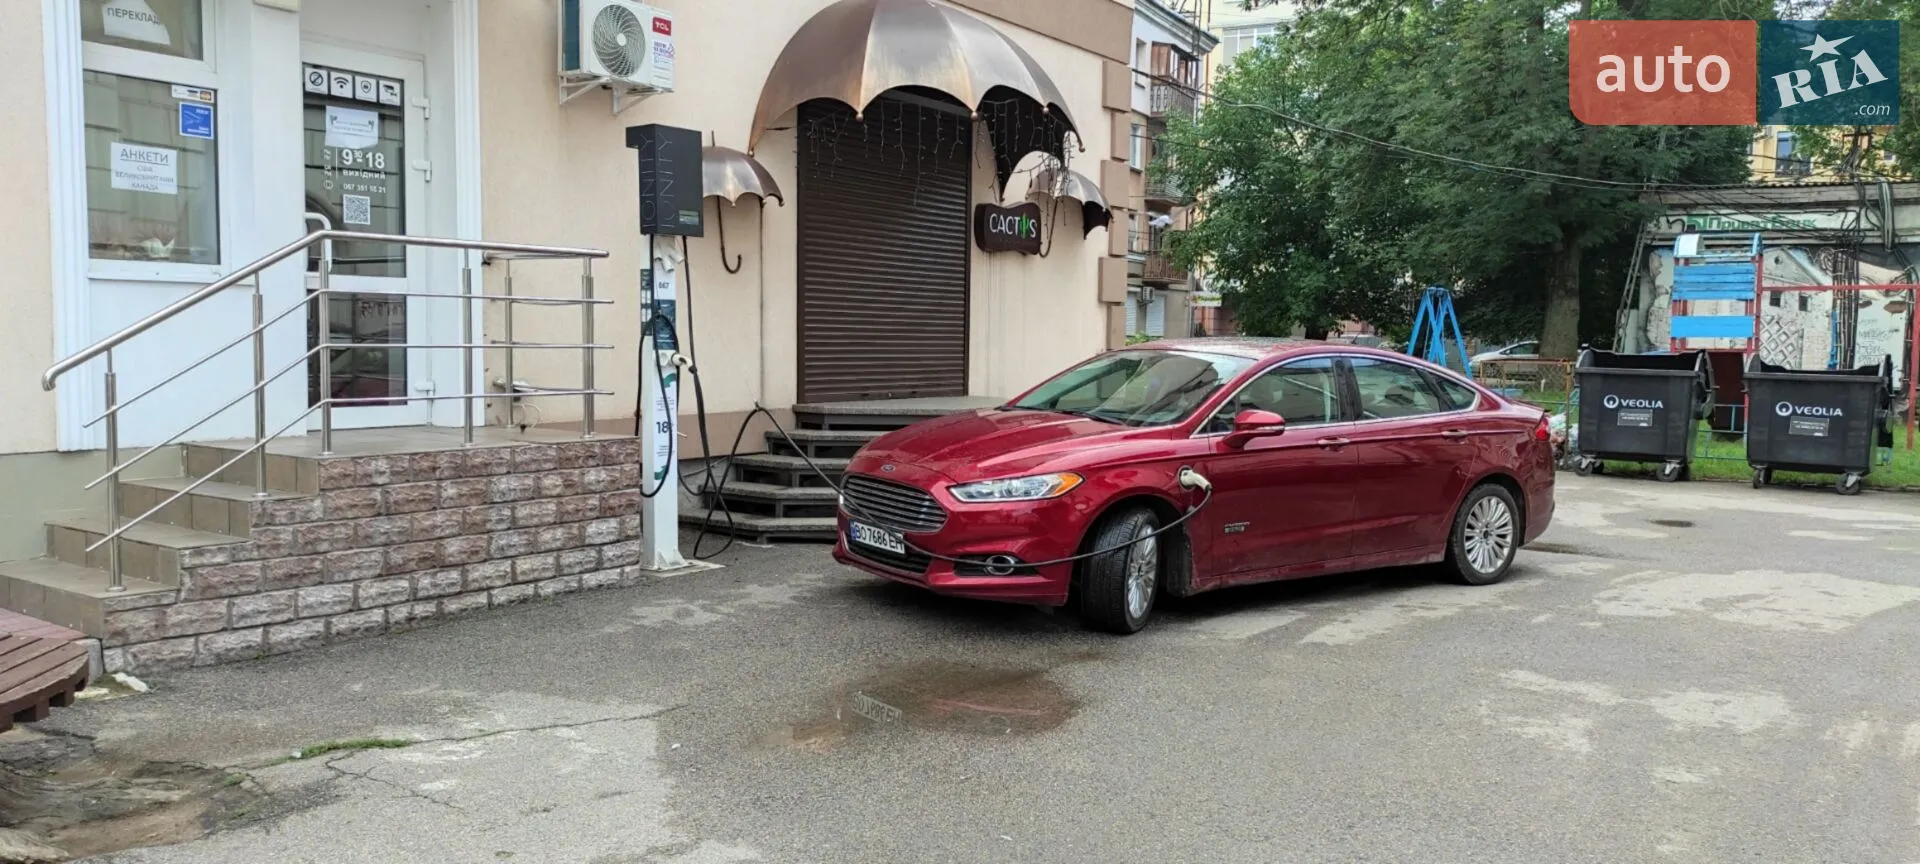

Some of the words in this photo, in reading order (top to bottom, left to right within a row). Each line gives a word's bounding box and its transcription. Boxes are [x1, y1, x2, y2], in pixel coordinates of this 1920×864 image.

[655, 21, 670, 31] TCL
[120, 148, 169, 164] АНКЕТИ
[1620, 398, 1664, 409] VEOLIA
[1794, 406, 1843, 417] VEOLIA
[867, 528, 888, 547] 7686
